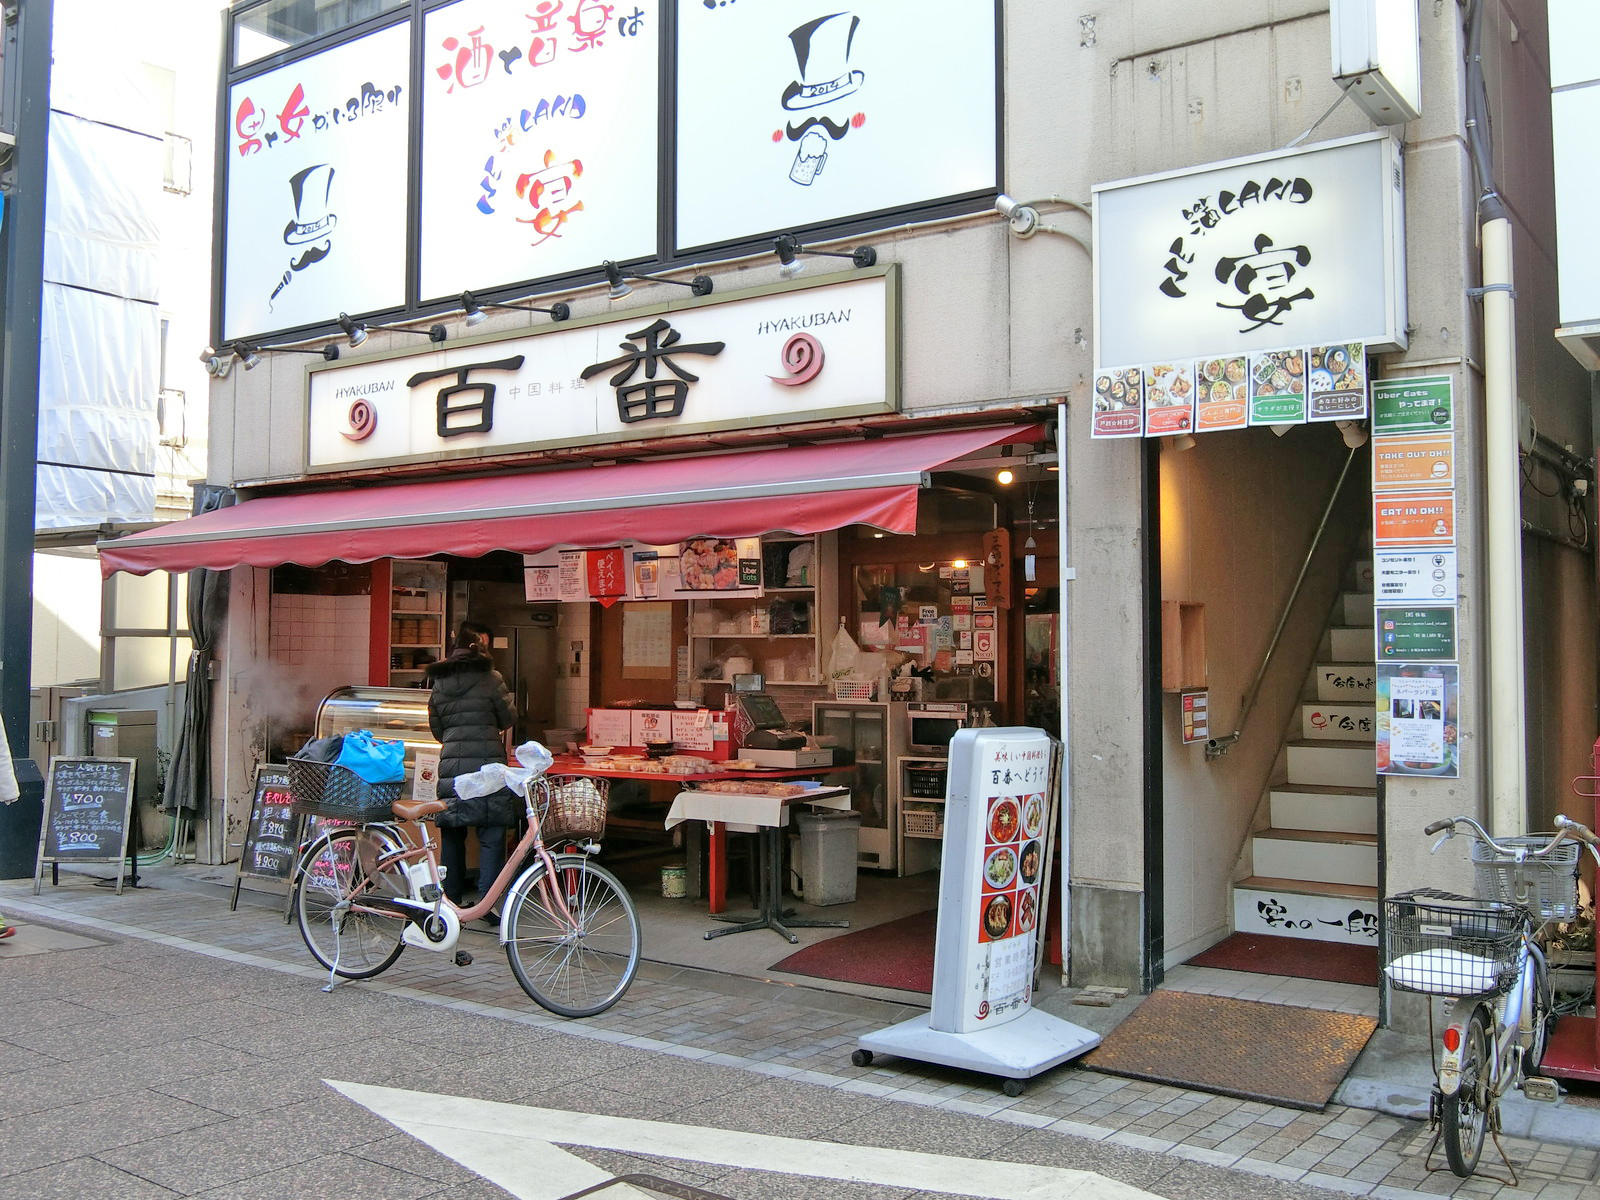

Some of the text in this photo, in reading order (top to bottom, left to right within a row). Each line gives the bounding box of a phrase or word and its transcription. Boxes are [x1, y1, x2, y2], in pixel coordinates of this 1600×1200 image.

[811, 80, 840, 97] 2014
[519, 93, 586, 133] LAND
[515, 149, 585, 247] 宴
[1218, 177, 1314, 215] LAND
[1214, 233, 1315, 334] 宴
[758, 308, 853, 336] HYAKUBAN
[335, 380, 396, 399] HYAKUBAN
[509, 377, 586, 401] 中国料理
[1377, 390, 1429, 400] Uber Eats
[1378, 452, 1404, 460] TAKE
[1380, 508, 1403, 516] EAT
[1405, 507, 1418, 515] IN
[597, 558, 607, 596] 使えます
[605, 551, 615, 590] ペイペイ
[742, 566, 758, 574] Uber
[742, 573, 758, 581] Eats
